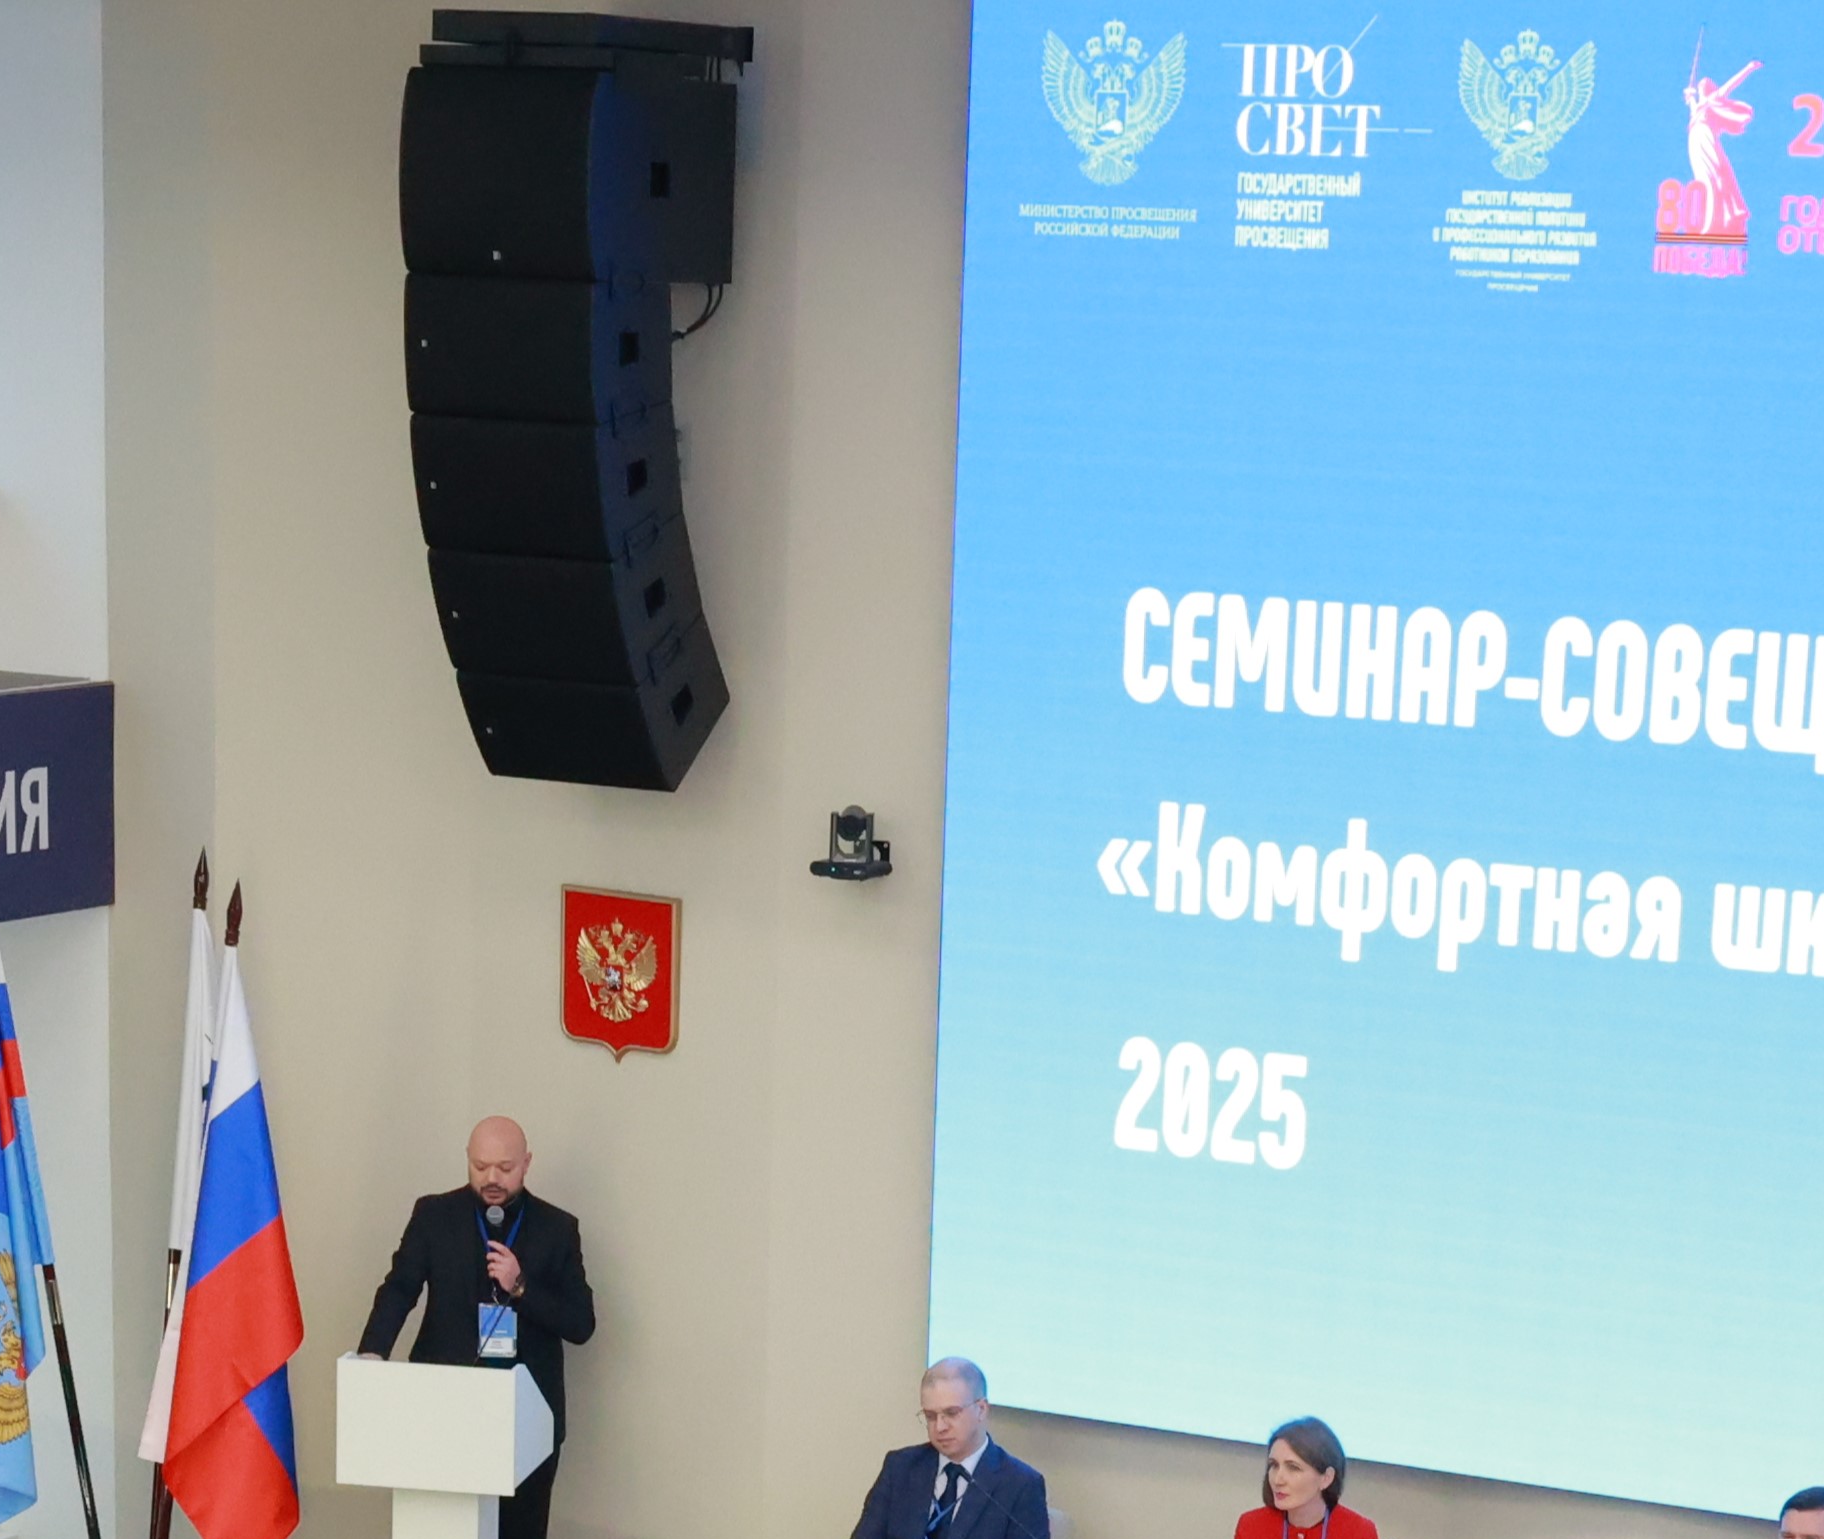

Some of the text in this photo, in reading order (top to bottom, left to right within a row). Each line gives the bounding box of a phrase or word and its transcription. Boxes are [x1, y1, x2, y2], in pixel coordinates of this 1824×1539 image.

[1238, 43, 1354, 99] ПРО
[1236, 101, 1381, 157] СВЕТ
[1237, 171, 1362, 197] ГОСУДАРСТВЕННЫЙ
[1019, 203, 1198, 223] МИНИСТЕРСТВО ПРОСВЕЩЕНИЯ
[1236, 198, 1325, 223] УНИВЕРСИТЕТ
[1034, 221, 1180, 241] РОССИЙСКОЙ ФЕДЕРАЦИИ
[1234, 225, 1330, 250] ПРОСВЕЩЕНИЯ
[1096, 799, 1683, 972] «Комфортная
[1113, 1035, 1309, 1170] 2025
